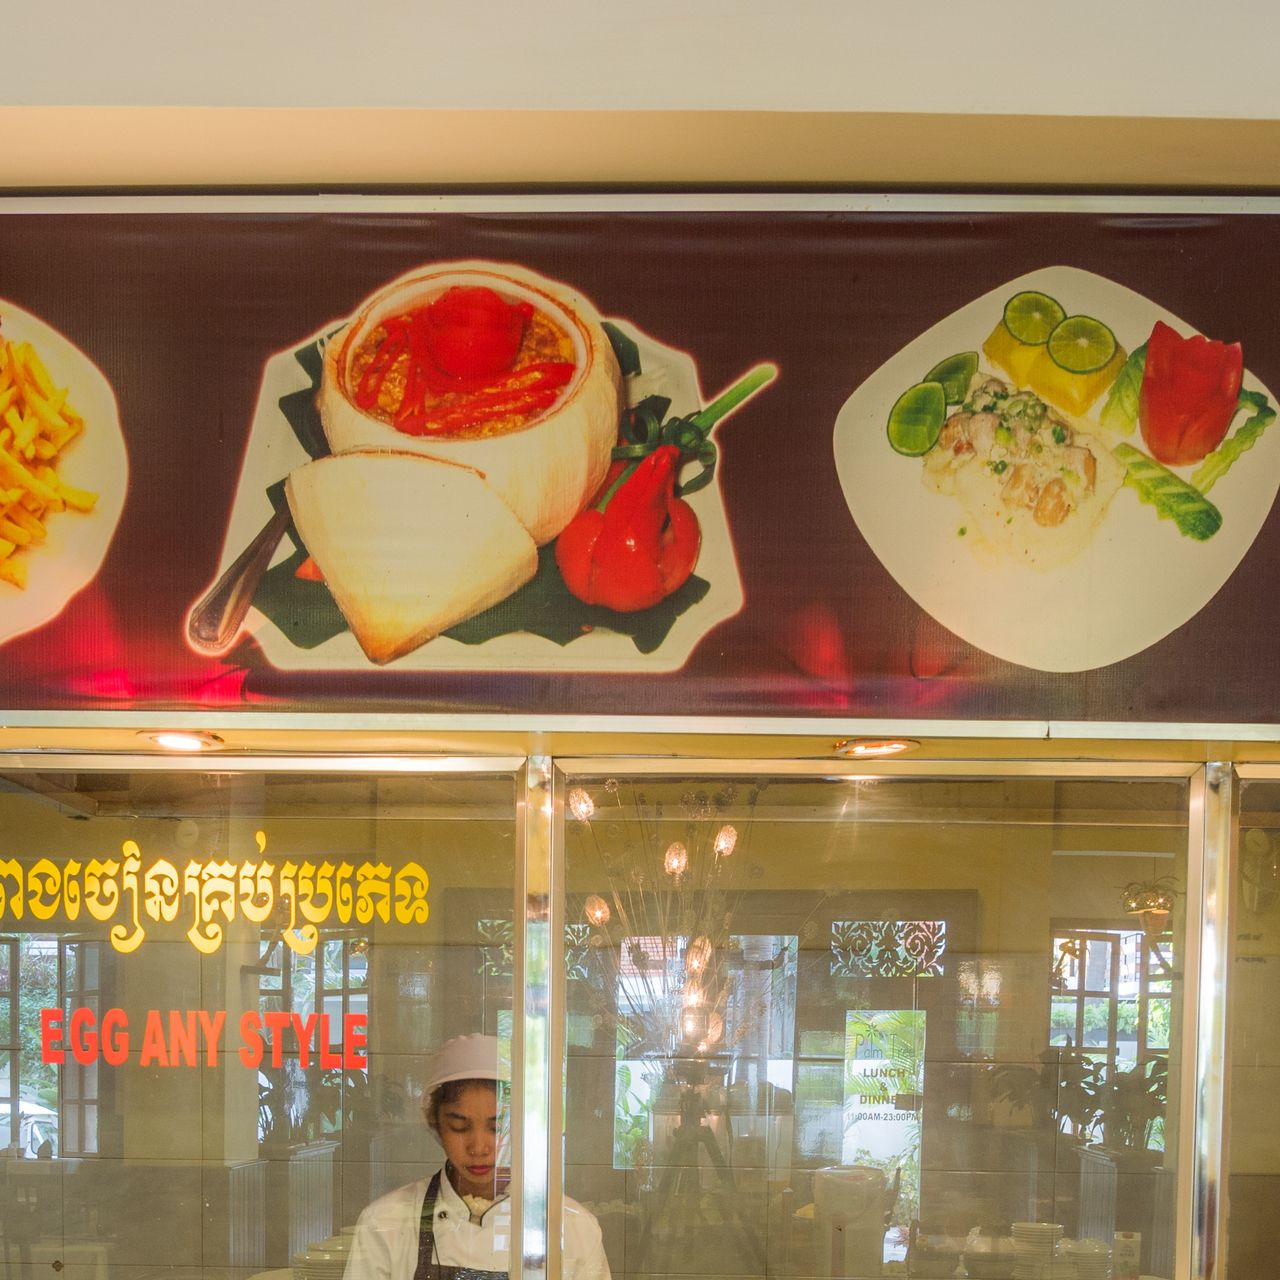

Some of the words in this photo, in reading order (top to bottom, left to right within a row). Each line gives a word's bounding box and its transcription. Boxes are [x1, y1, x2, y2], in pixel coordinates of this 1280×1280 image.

[41, 1008, 129, 1065] EGG
[141, 1010, 226, 1067] ANY
[239, 1011, 368, 1069] STYLE
[863, 1068, 906, 1078] LUNCH
[879, 1082, 888, 1093] &
[859, 1094, 897, 1105] DINNE
